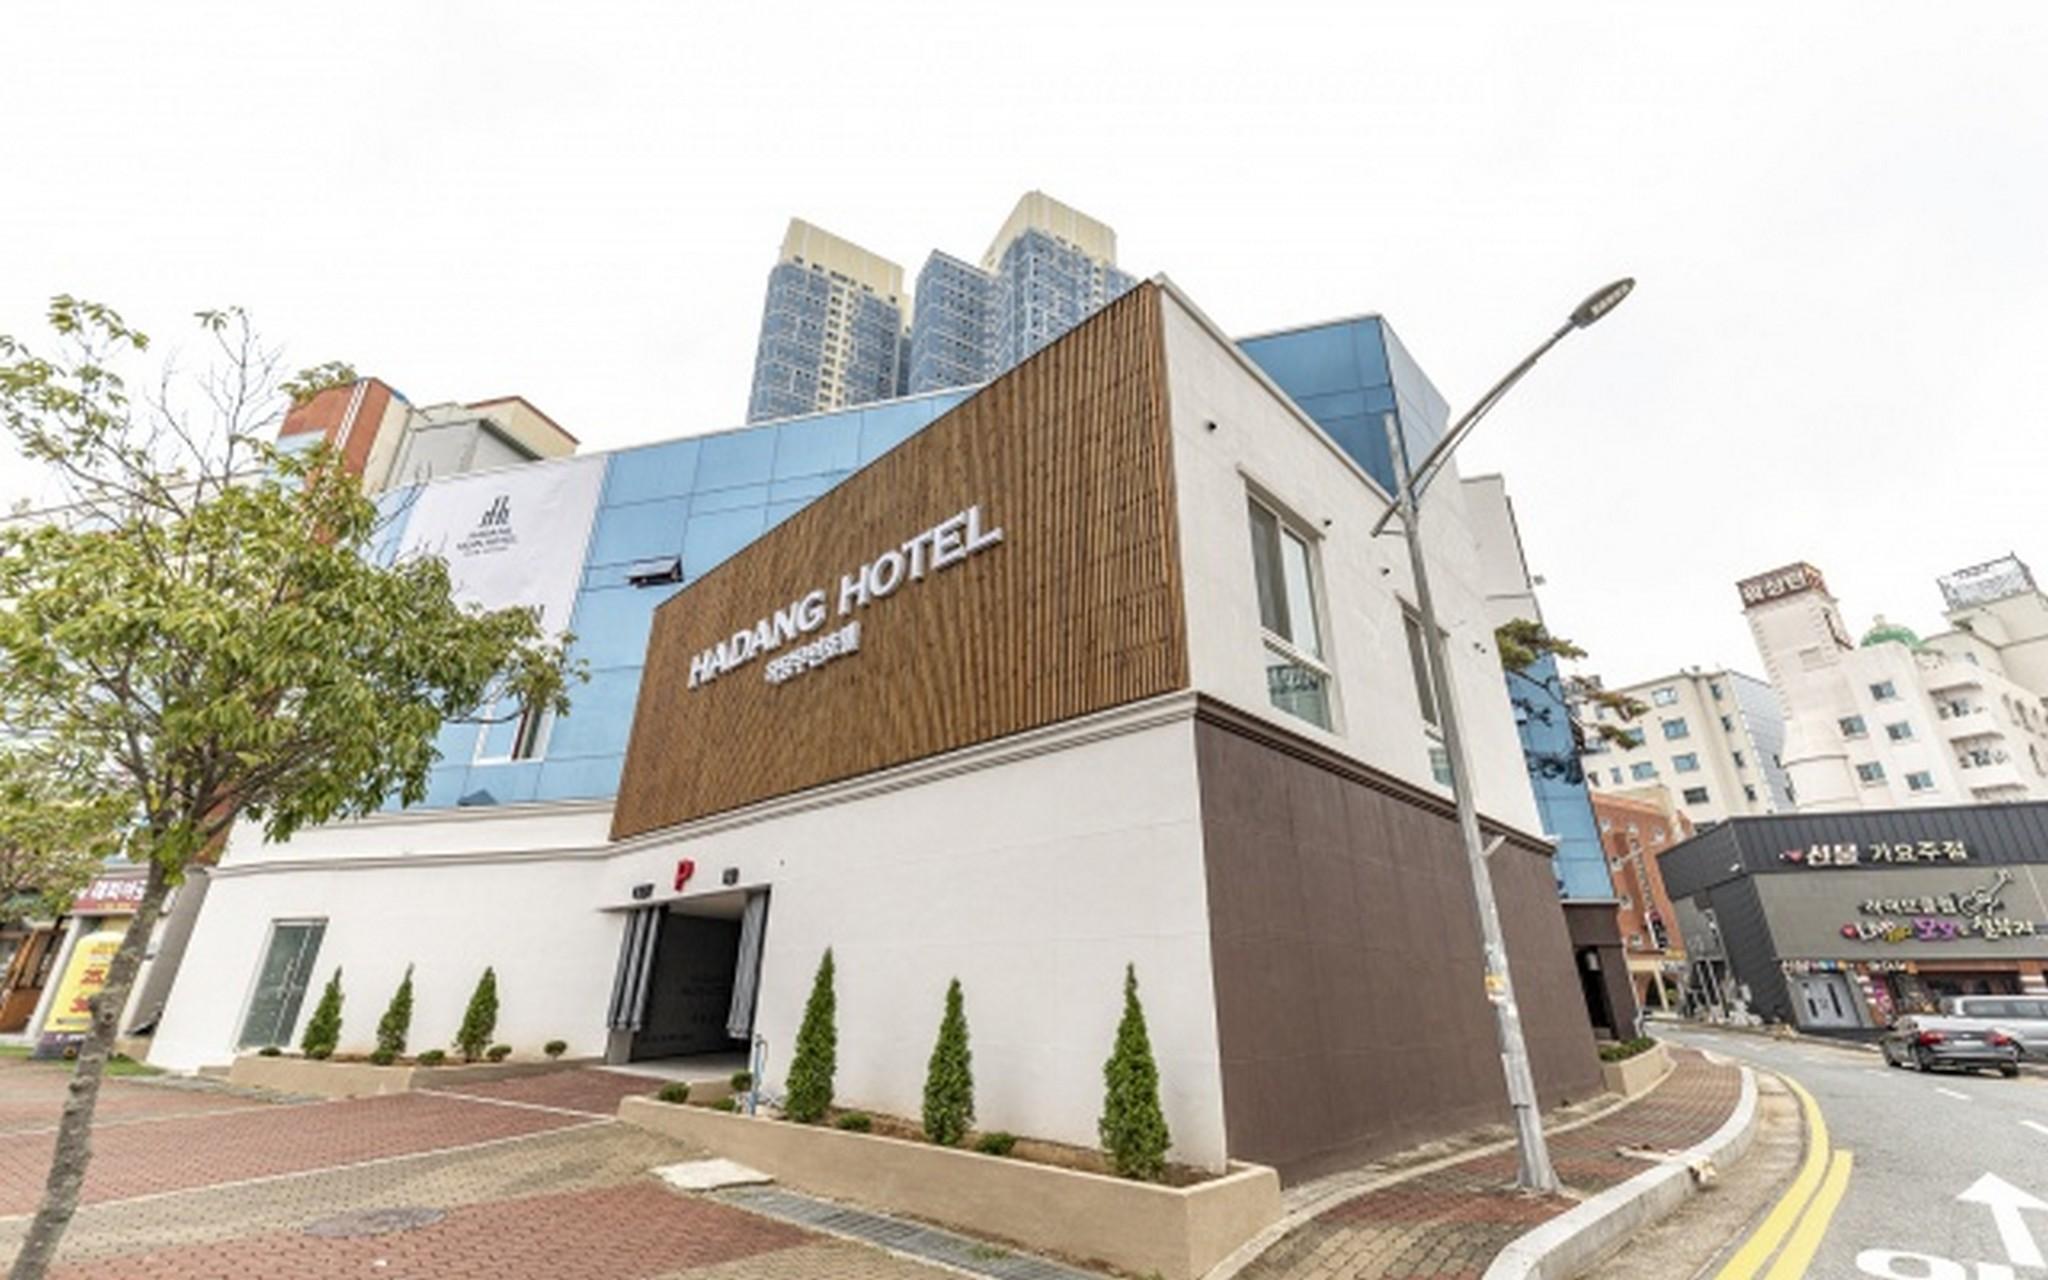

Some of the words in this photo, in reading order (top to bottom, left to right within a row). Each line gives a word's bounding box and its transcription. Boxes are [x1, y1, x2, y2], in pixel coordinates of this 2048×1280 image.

[687, 588, 827, 690] HADANG
[838, 504, 1004, 616] HOTEL
[674, 859, 695, 892] P
